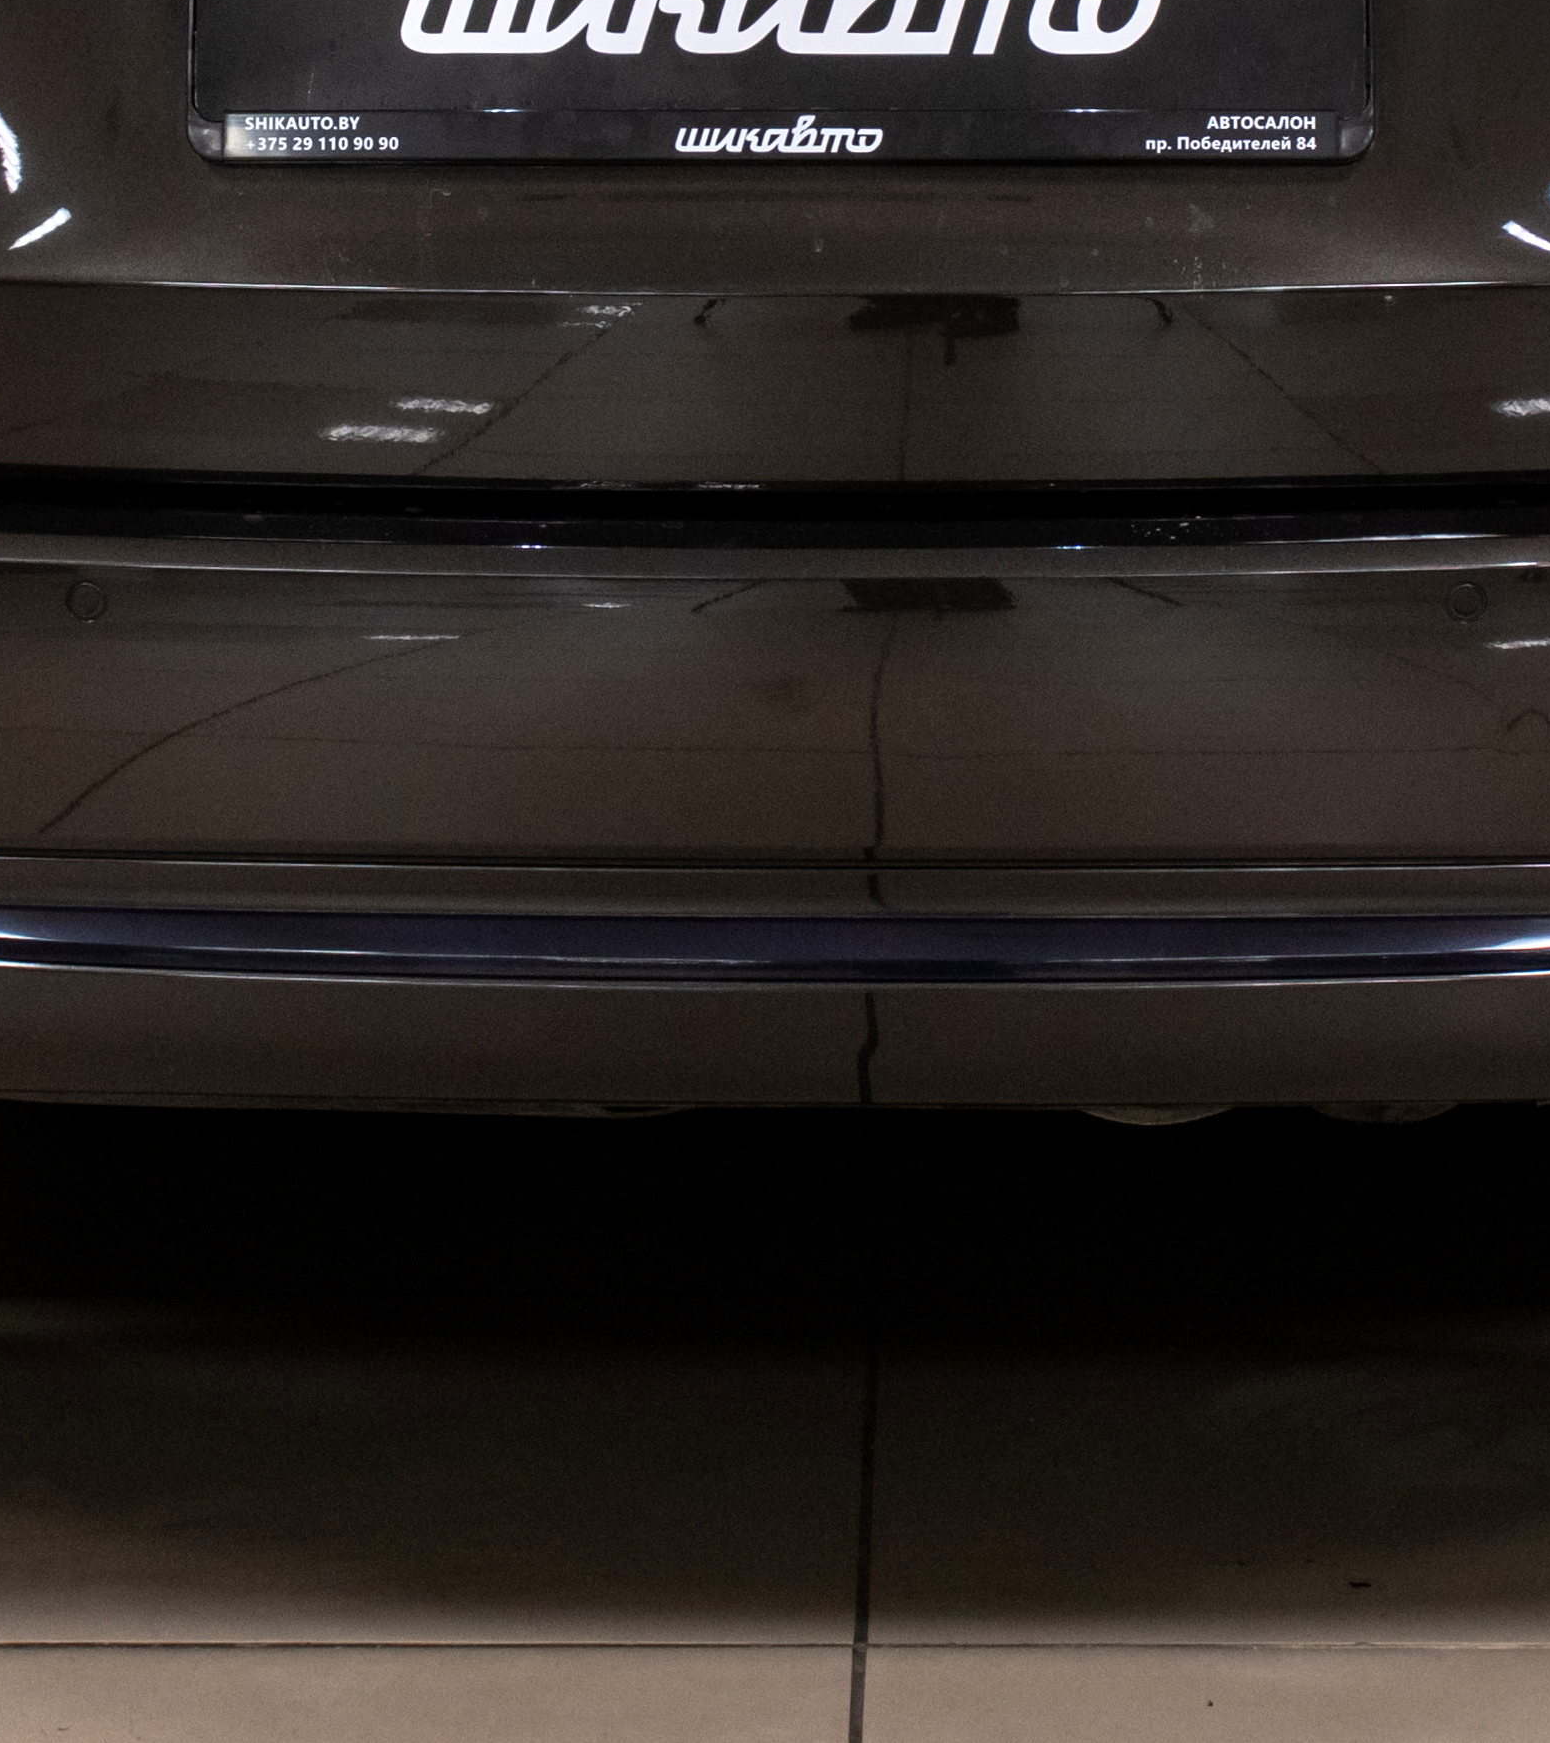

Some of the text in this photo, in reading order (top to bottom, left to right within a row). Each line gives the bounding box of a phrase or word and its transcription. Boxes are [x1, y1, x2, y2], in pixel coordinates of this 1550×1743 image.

[244, 116, 360, 131] SHIKAUTO.BY
[1206, 115, 1317, 130] АВТОСАЛОН
[674, 114, 884, 154] шикавто
[246, 136, 400, 151] +375 29 110 90 90
[1145, 135, 1318, 154] пр. Победителей 84
